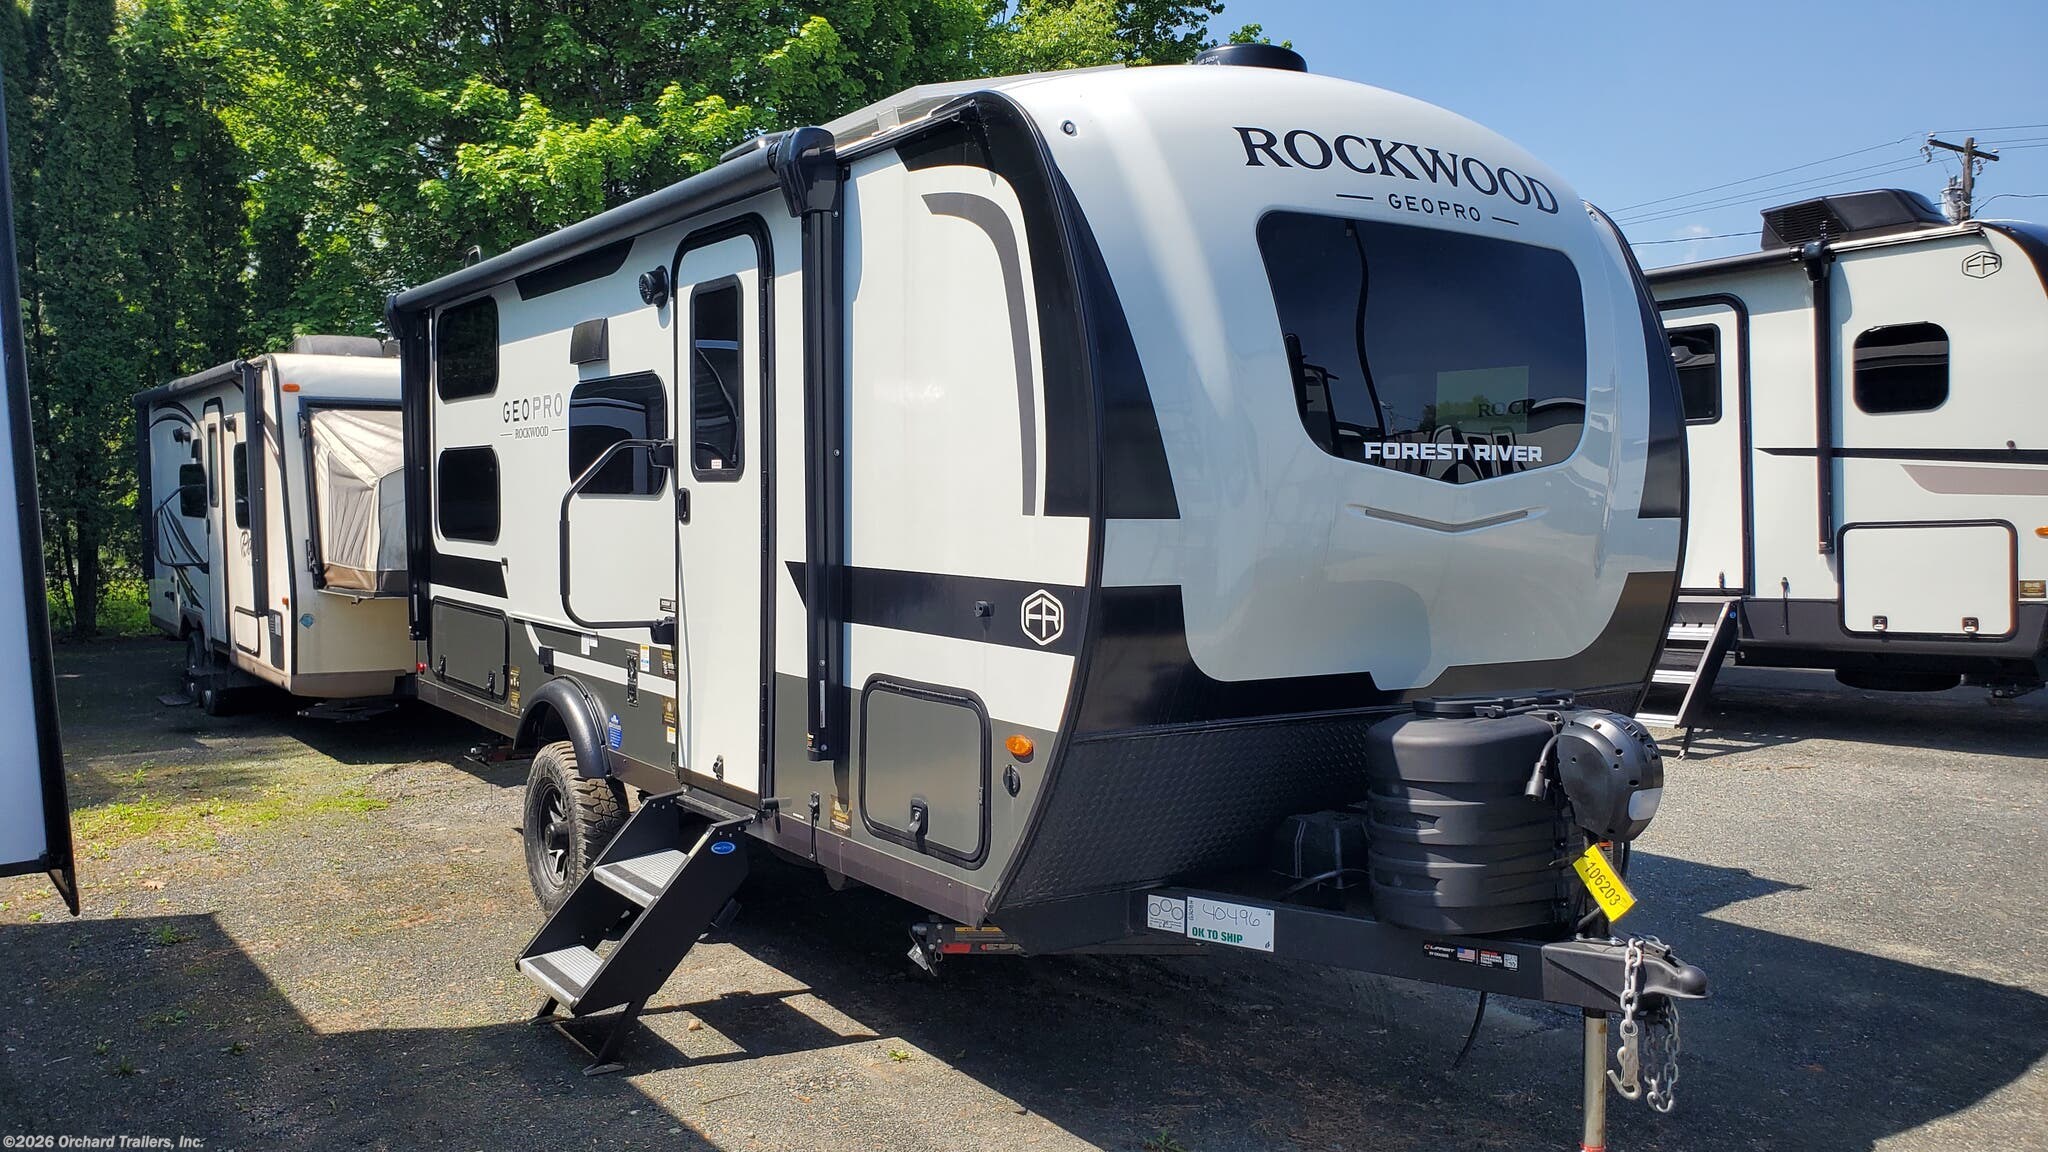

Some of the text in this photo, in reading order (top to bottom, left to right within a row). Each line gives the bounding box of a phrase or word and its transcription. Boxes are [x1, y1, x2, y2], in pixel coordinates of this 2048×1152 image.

[1231, 126, 1560, 215] ROCKWOOD
[1387, 193, 1481, 223] GEOPRO
[502, 392, 563, 424] GEOPRO
[514, 425, 549, 439] ROCKWOOD
[1363, 441, 1543, 463] FOREST RIVER
[1583, 861, 1622, 907] 106203
[1202, 903, 1261, 927] 40496
[1191, 926, 1244, 944] OK TO SHIP
